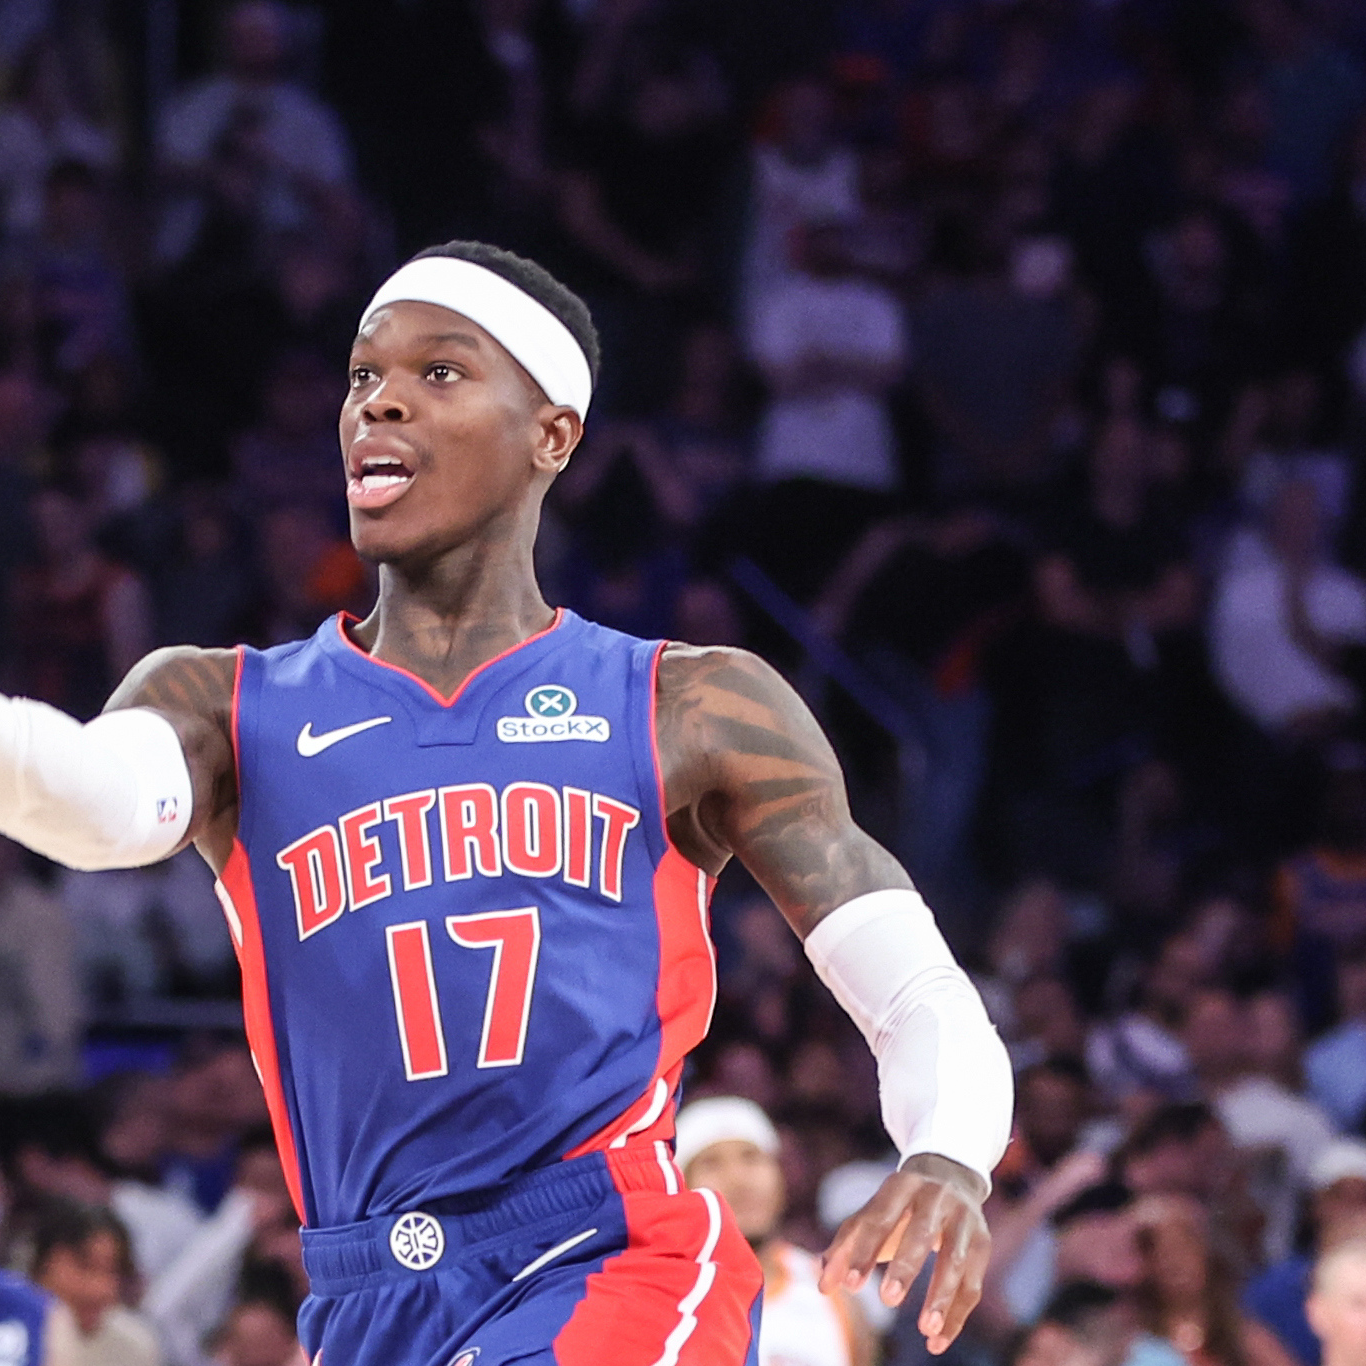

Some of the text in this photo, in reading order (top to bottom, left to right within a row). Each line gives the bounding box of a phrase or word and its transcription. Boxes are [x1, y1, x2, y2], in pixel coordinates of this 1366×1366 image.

[501, 719, 604, 737] StockX
[276, 781, 641, 942] DETROIT
[385, 906, 541, 1081] 17
